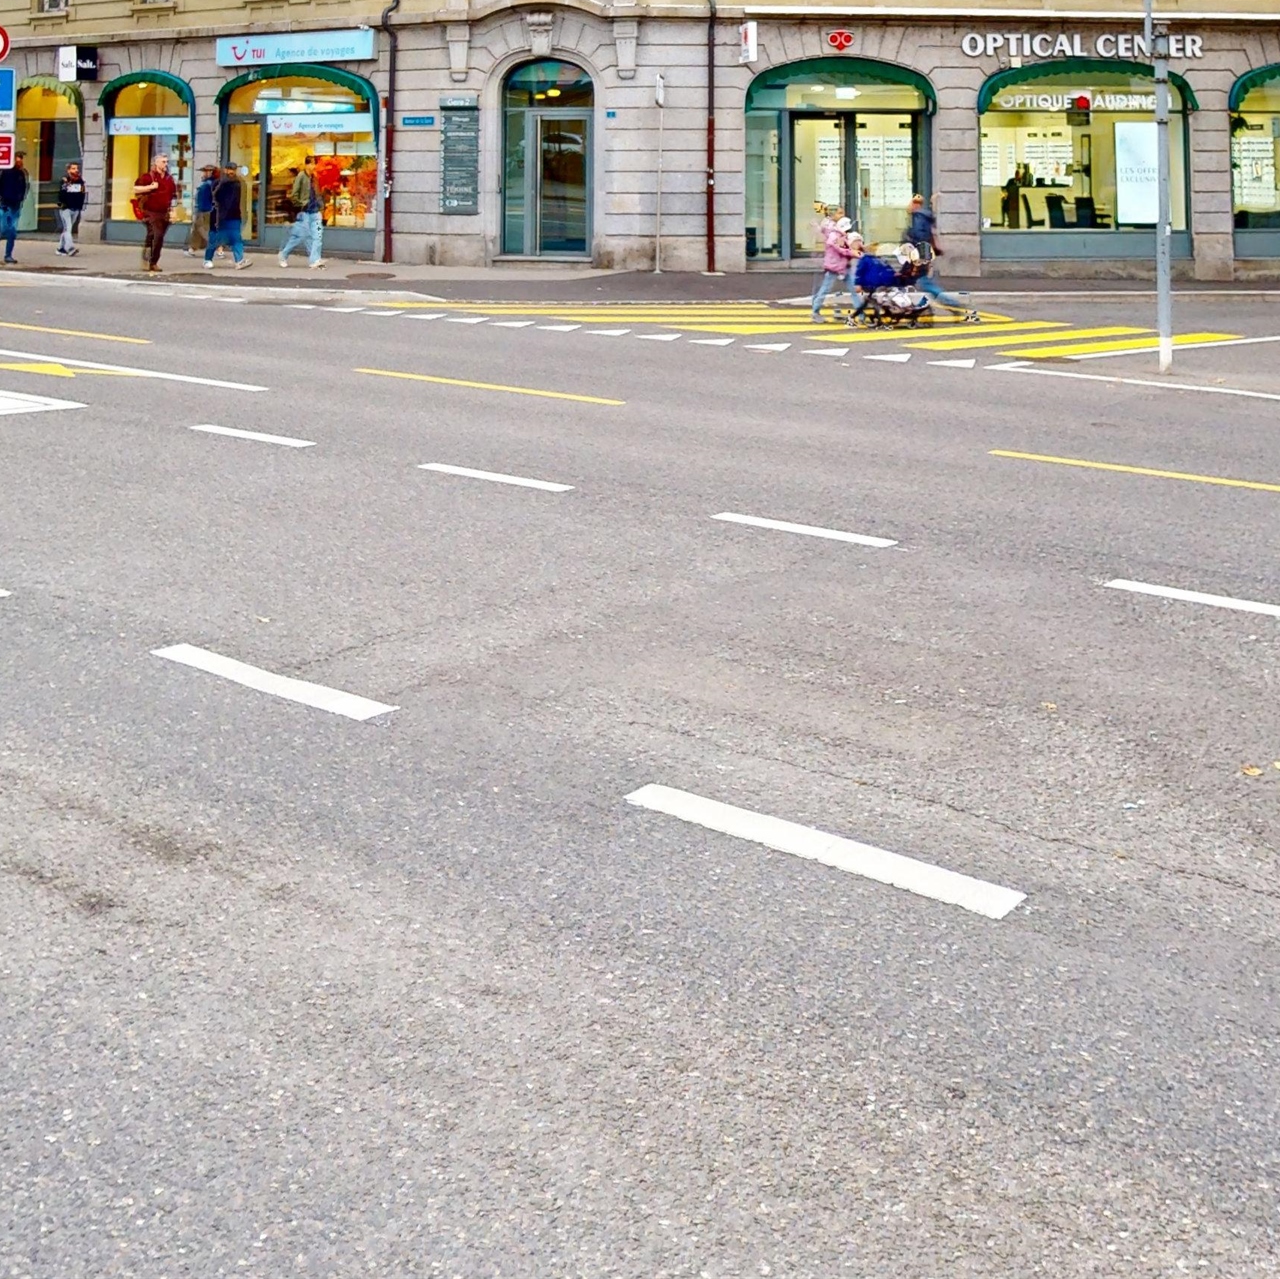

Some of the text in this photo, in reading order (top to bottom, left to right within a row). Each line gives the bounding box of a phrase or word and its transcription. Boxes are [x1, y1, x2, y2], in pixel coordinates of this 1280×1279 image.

[251, 46, 355, 60] TUI Agence de voyages
[961, 33, 1204, 58] OPTICAL CENER
[77, 59, 97, 69] Salt.
[999, 94, 1072, 111] OPTIQUE
